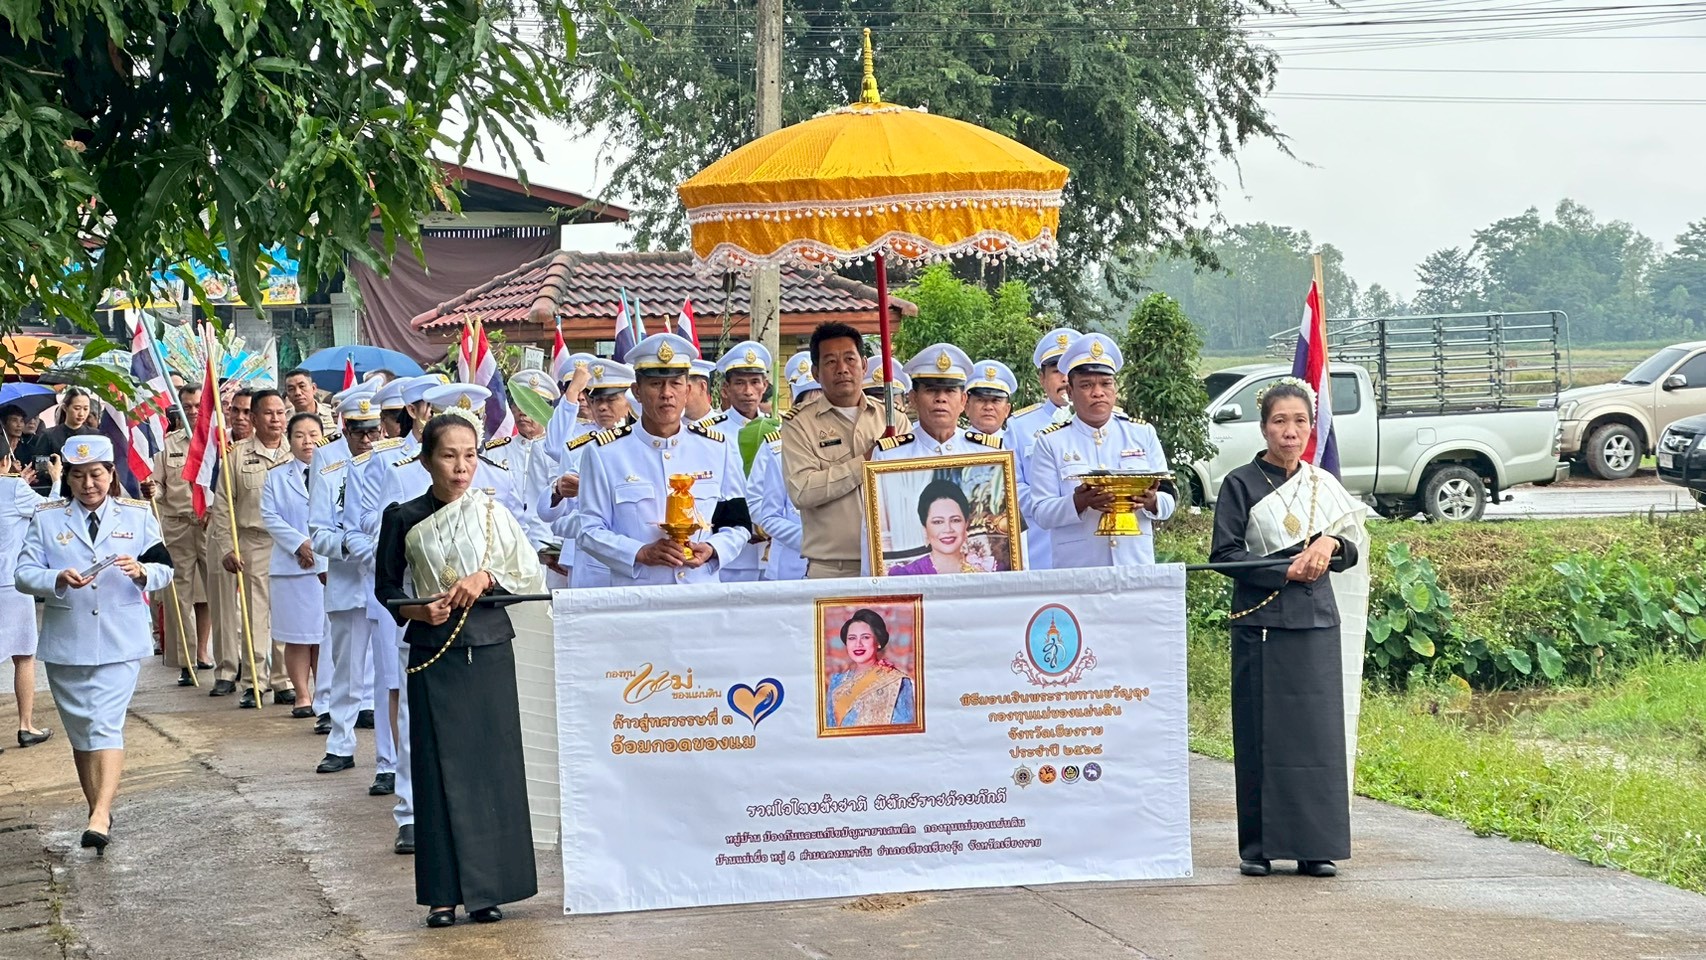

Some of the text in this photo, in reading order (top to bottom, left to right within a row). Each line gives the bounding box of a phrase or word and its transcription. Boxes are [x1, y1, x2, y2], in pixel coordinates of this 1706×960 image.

[605, 668, 637, 681] กองทุน
[613, 707, 718, 732] ก้าวสู่ทศวรรษที่
[988, 703, 1122, 724] กองทุนแม่ของแผ่นดิน
[1008, 724, 1104, 740] จังหวัดเชียงราย
[1009, 743, 1060, 759] ประจำปี
[746, 794, 867, 817] รวมใจไทยทั้งชาติ
[725, 832, 761, 847] หมู่บ้าน
[923, 816, 1026, 835] กองทุนแม่ของแผ่นดิน
[770, 850, 786, 865] หมู่
[787, 851, 796, 861] 4
[968, 837, 1042, 851] จังหวัดเชียงราย
